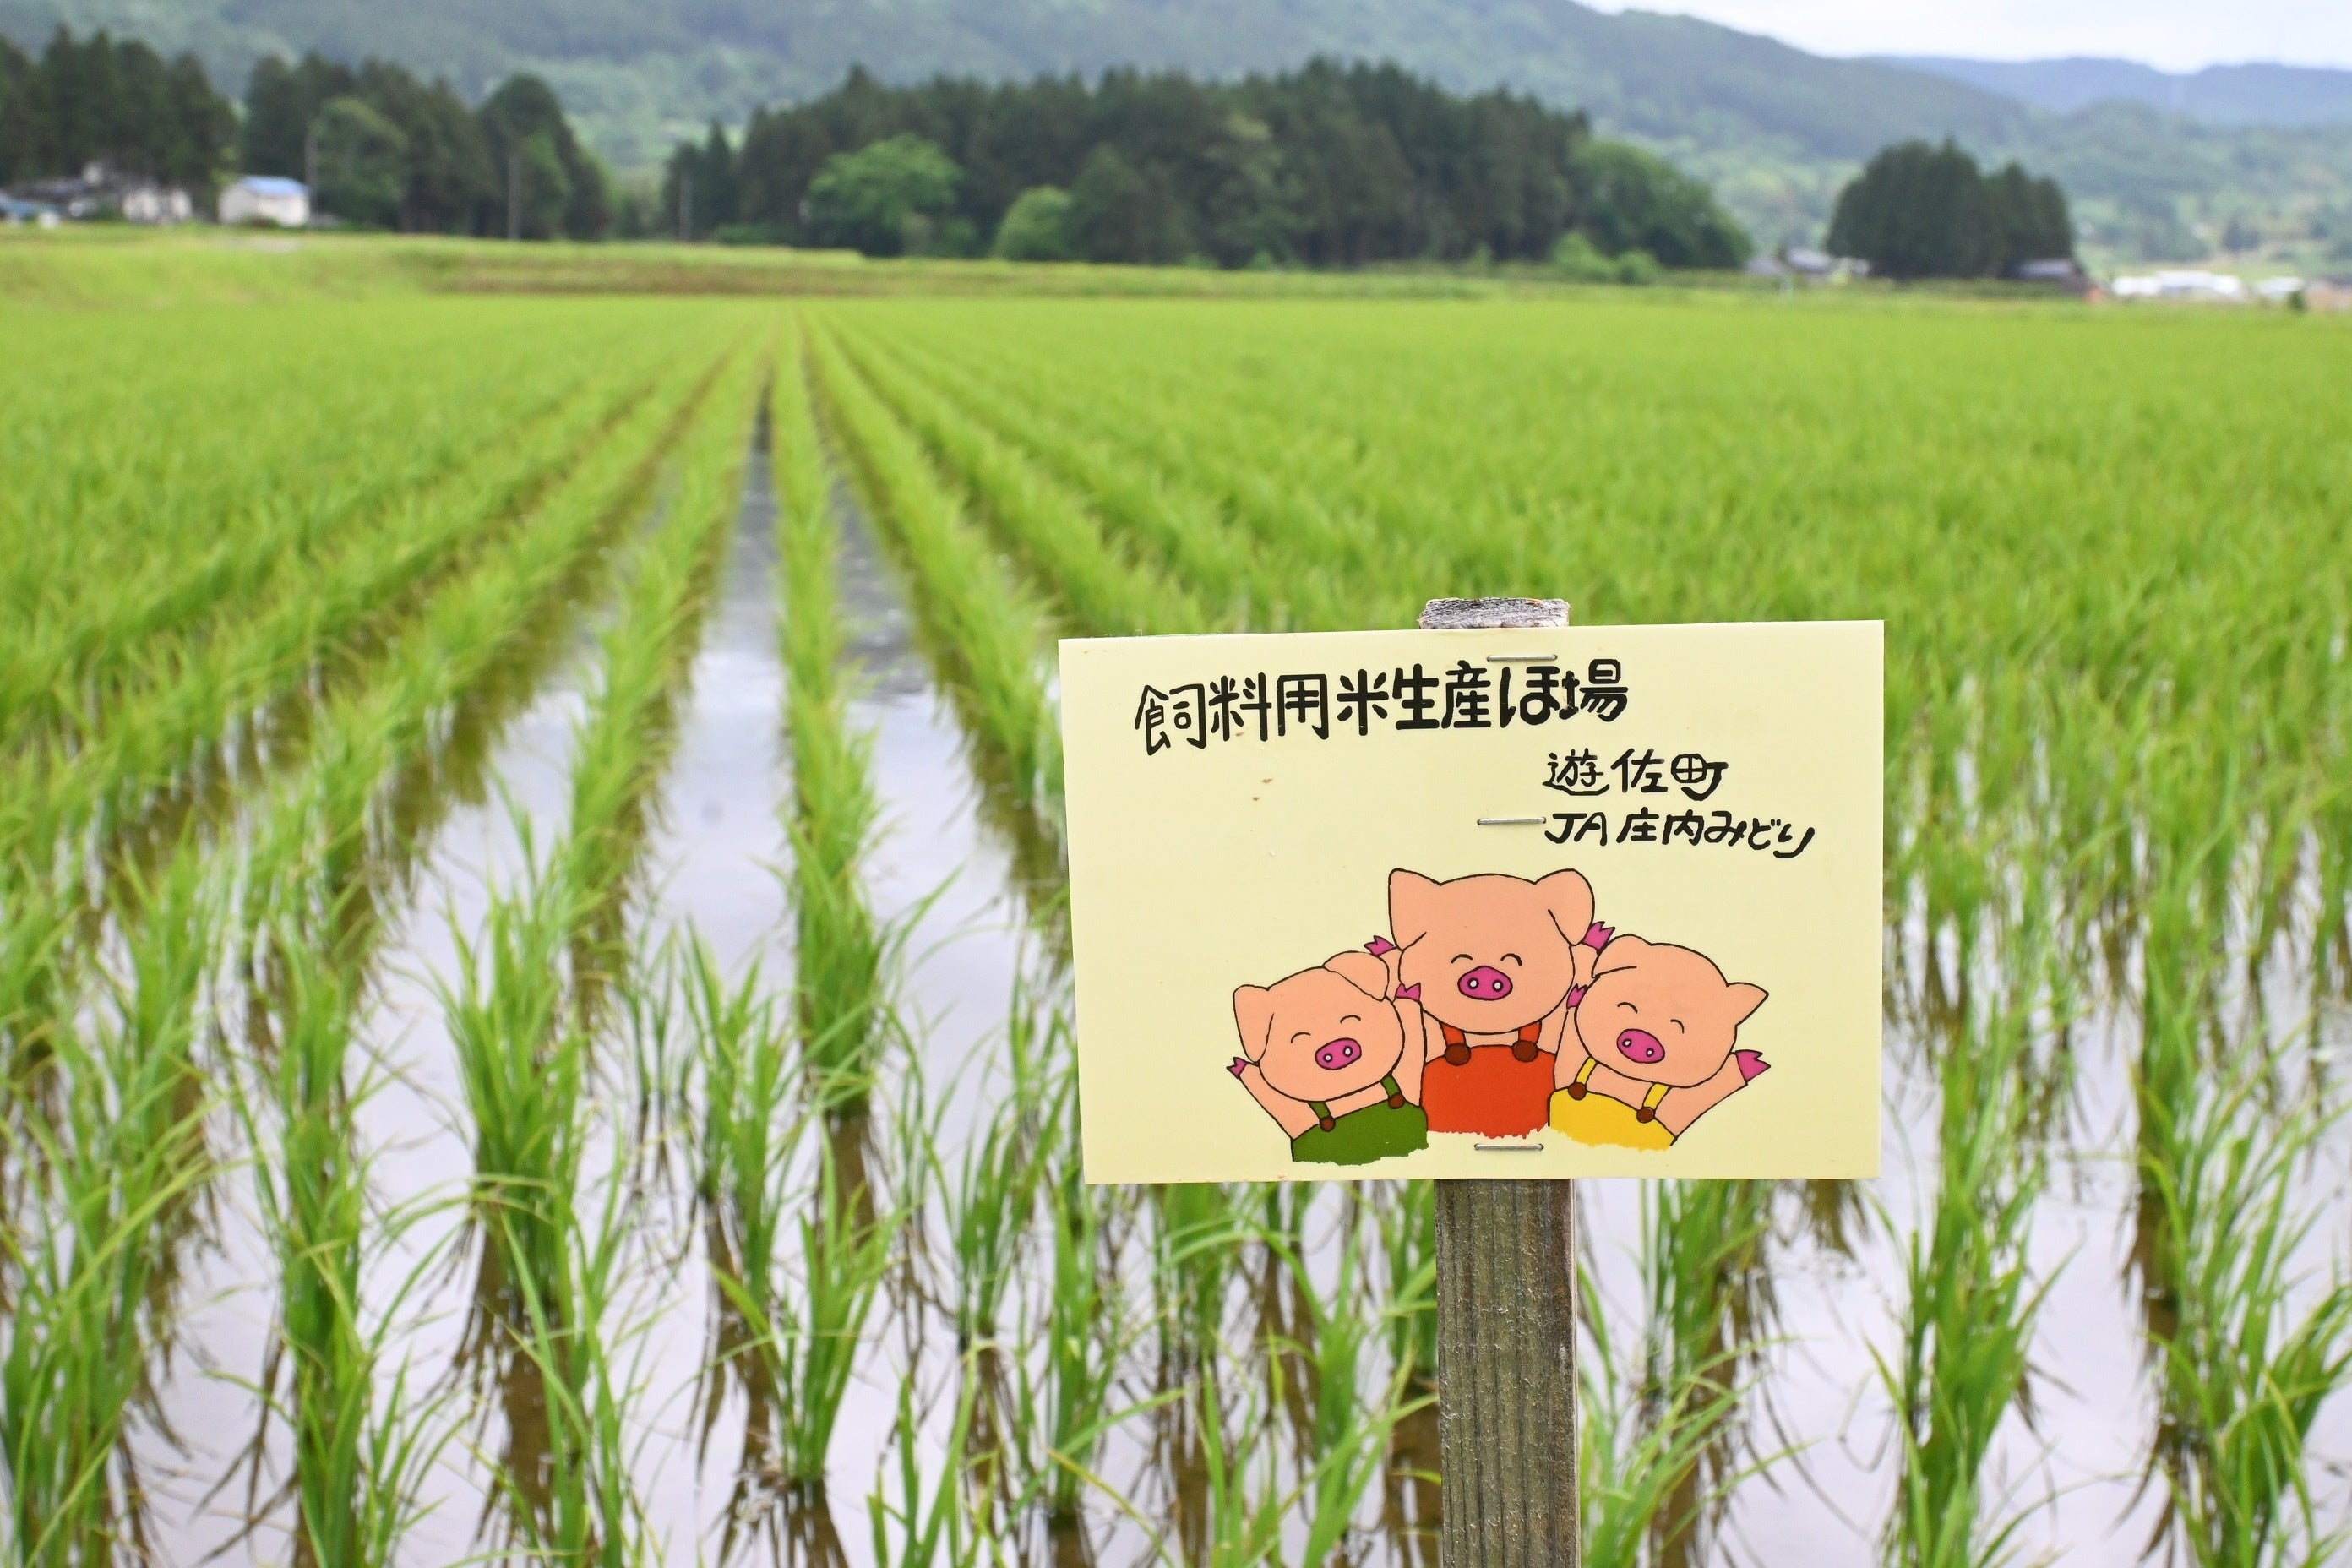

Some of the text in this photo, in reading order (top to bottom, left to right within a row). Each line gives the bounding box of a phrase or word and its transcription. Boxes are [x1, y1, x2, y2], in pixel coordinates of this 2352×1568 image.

[1135, 658, 1629, 756] 飼料用米生産ほ場
[1542, 748, 1729, 802] 遊佐町
[1544, 806, 1816, 859] JA庄内みどり
